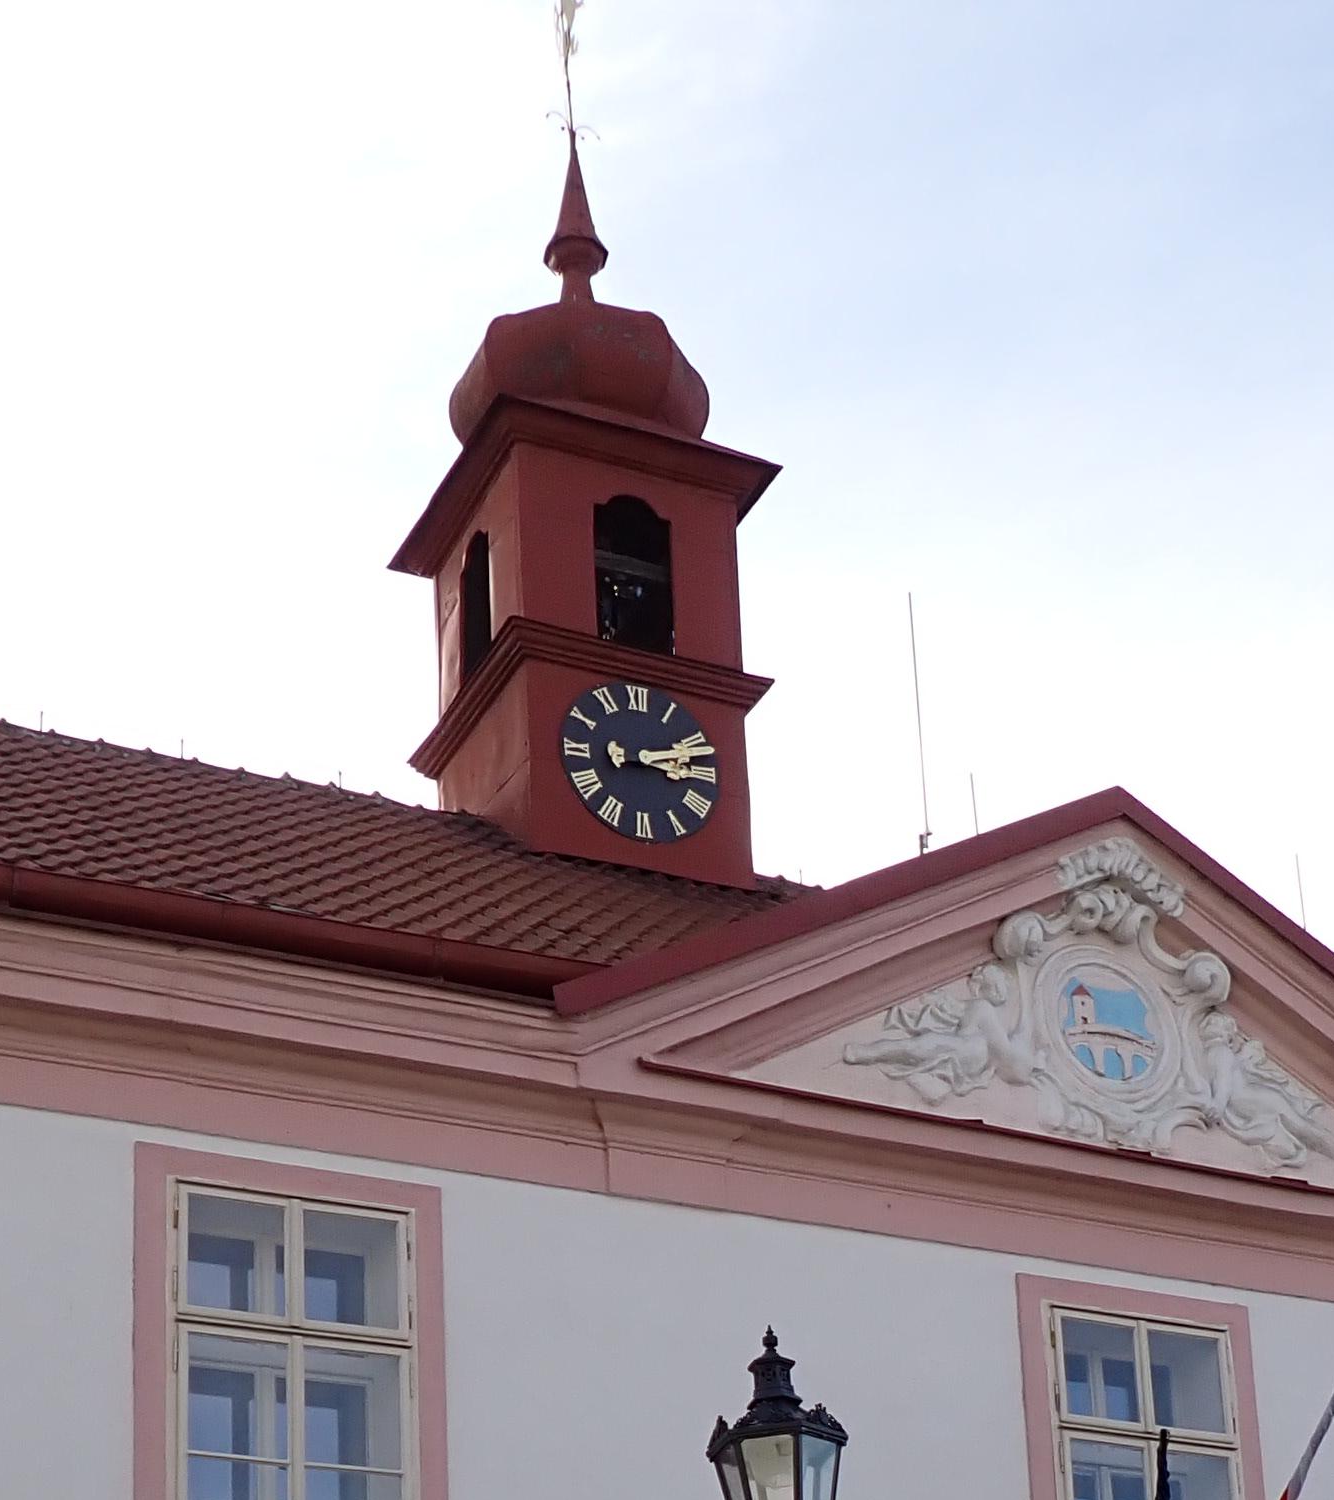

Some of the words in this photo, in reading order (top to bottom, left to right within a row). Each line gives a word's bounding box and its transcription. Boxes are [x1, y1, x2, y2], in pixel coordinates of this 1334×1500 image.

[593, 686, 619, 715] XI
[625, 685, 649, 712] XII
[661, 702, 677, 723] I
[569, 706, 597, 730] X
[571, 768, 603, 800] VIII
[597, 795, 624, 827] VII
[682, 788, 712, 819] IIII
[635, 811, 654, 839] VI
[666, 810, 687, 836] V
